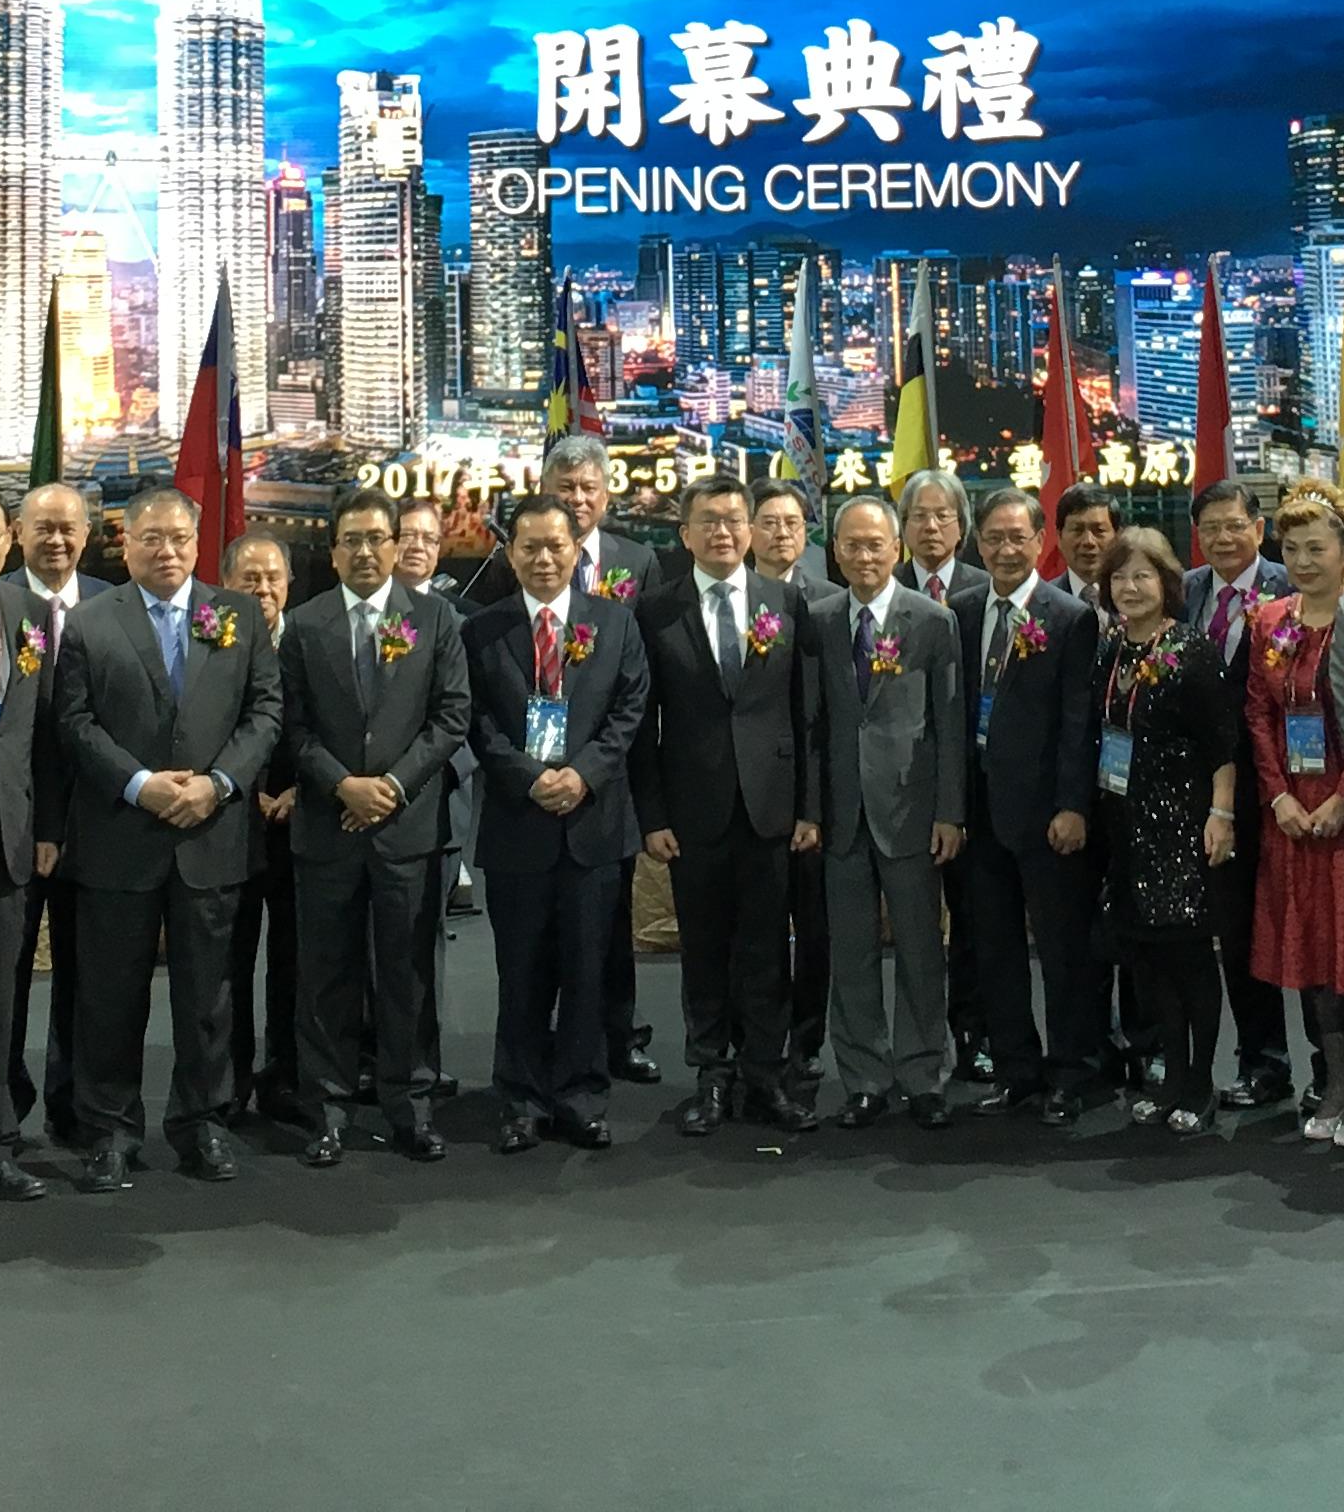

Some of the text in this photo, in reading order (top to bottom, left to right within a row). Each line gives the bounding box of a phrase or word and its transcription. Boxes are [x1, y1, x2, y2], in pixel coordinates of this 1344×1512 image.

[533, 15, 1044, 148] 開幕典禮
[492, 160, 1081, 214] OPENING CEREMONY
